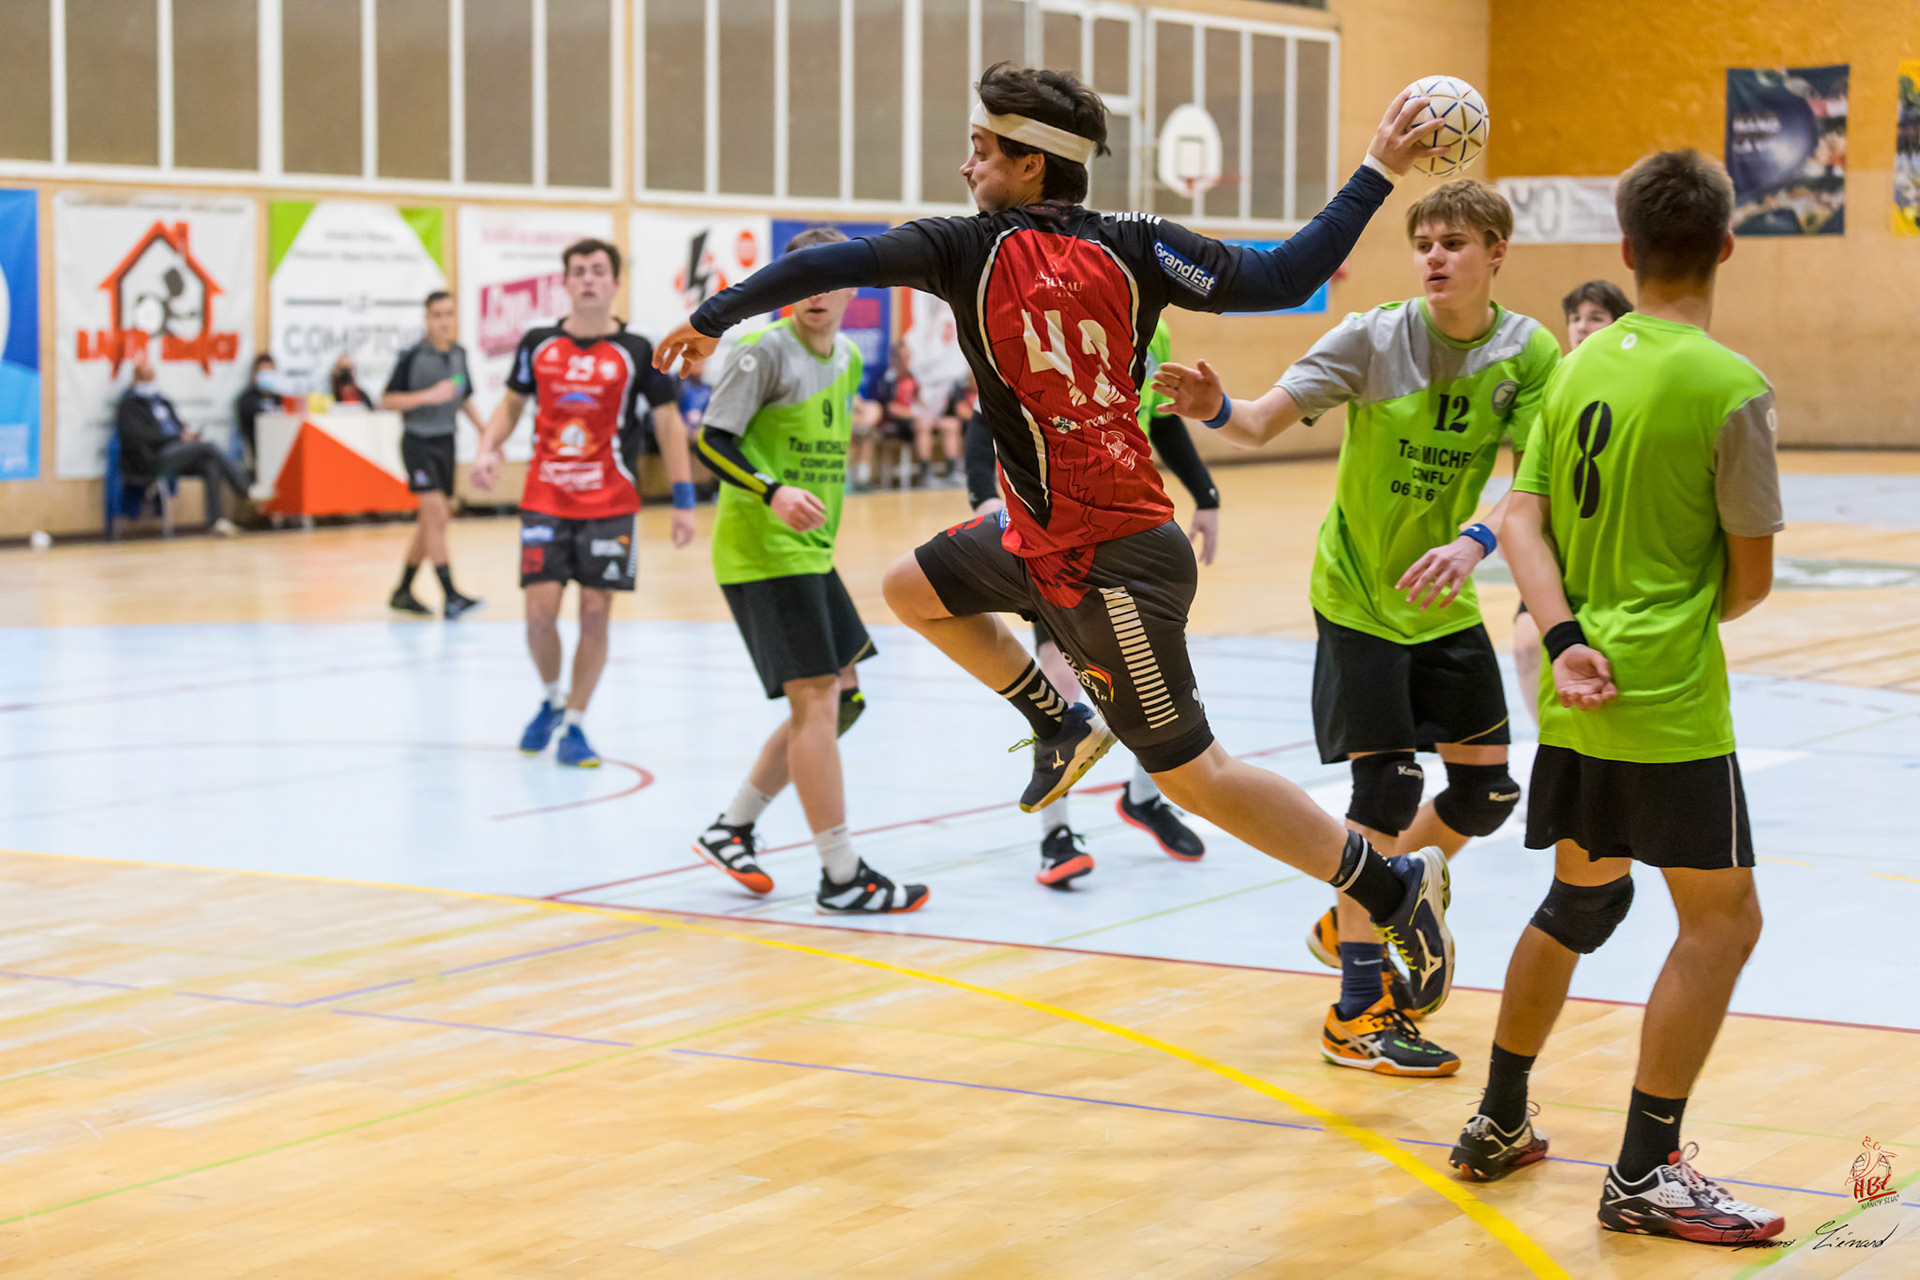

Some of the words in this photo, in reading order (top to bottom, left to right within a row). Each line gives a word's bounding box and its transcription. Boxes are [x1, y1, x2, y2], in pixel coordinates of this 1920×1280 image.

[565, 354, 596, 381] 25
[822, 398, 833, 429] 9
[1433, 394, 1470, 433] 12
[1573, 400, 1613, 519] 8
[1390, 479, 1412, 497] 06
